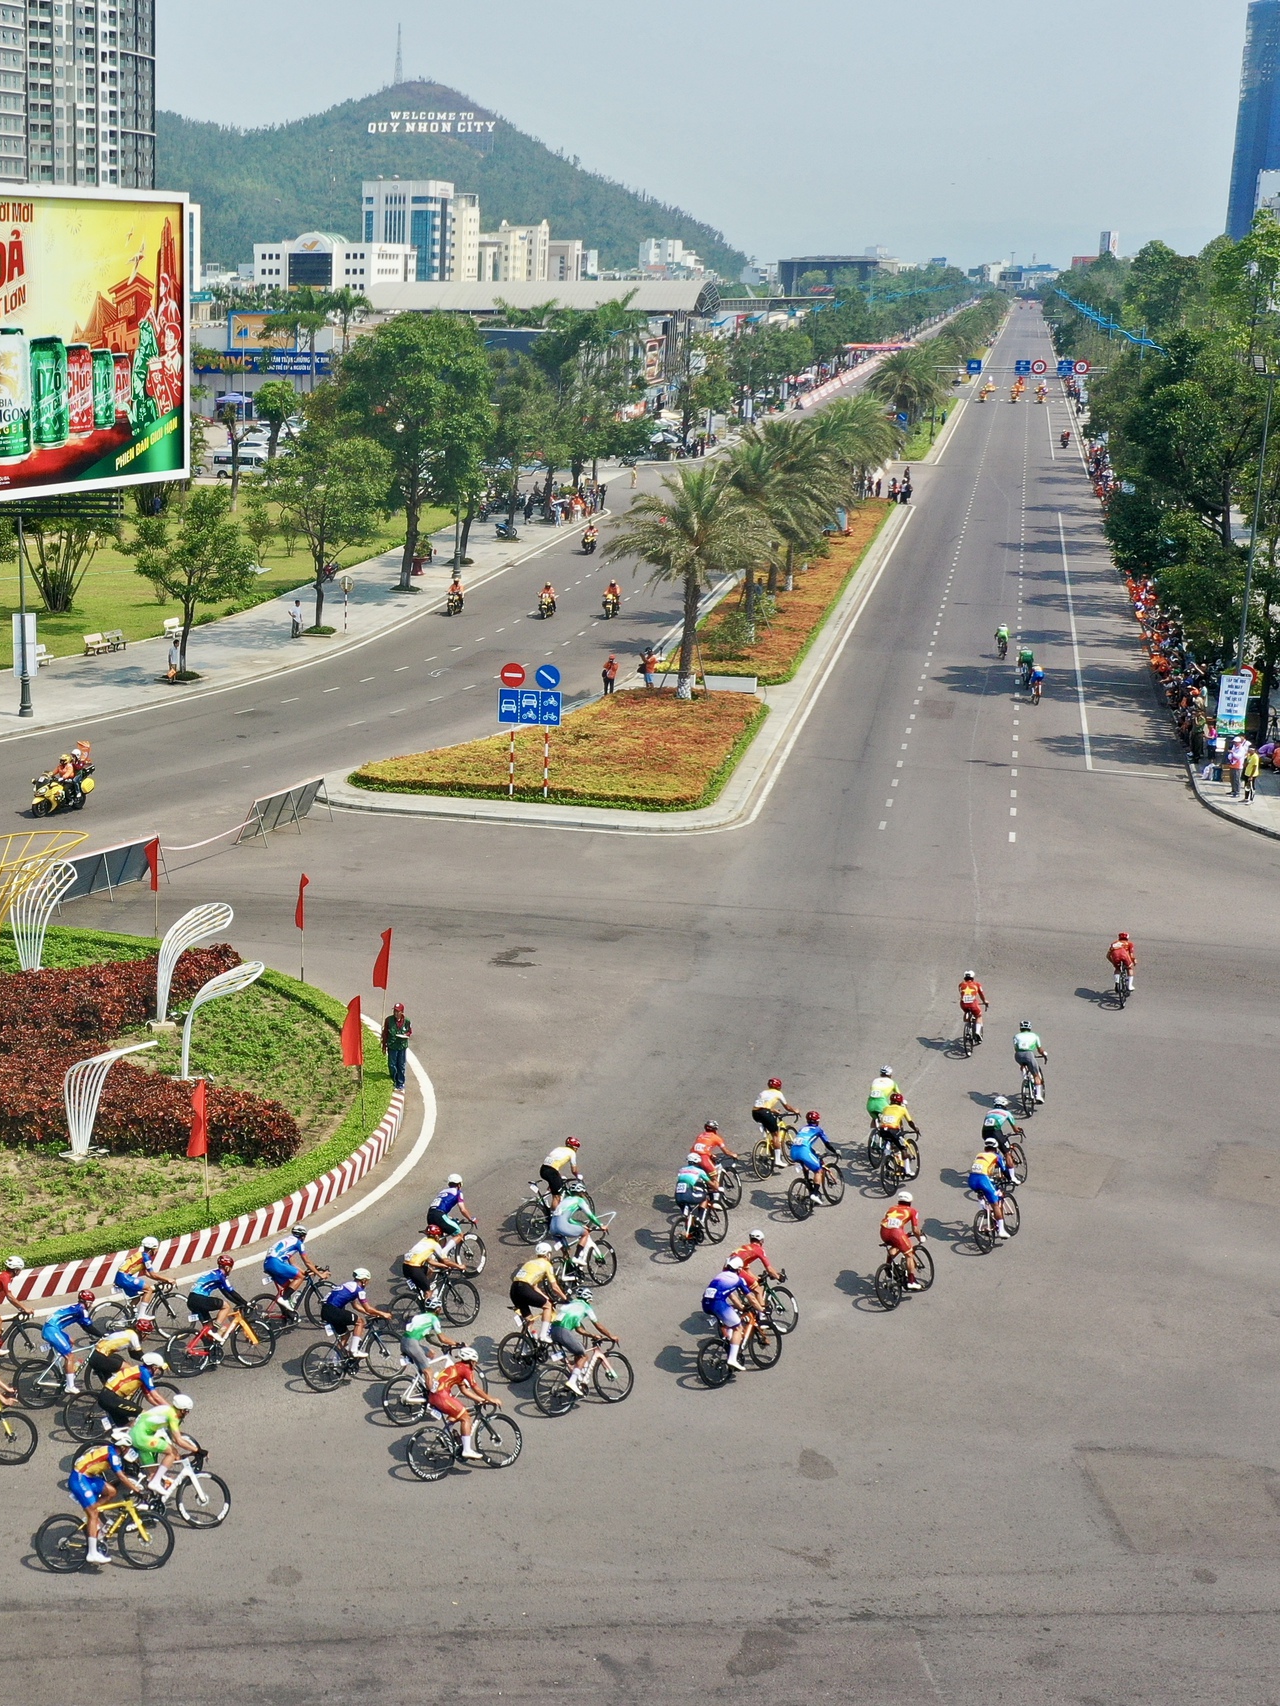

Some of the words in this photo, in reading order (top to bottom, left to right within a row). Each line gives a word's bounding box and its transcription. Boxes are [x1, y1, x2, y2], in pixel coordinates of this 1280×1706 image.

[367, 122, 400, 134] QUY
[405, 122, 452, 133] NHON
[457, 121, 496, 133] CITY
[390, 111, 456, 121] WELCOME
[459, 112, 474, 120] TO
[11, 202, 33, 223] MỜI
[3, 284, 26, 315] LỚN
[67, 369, 92, 397] CHÚC
[135, 436, 149, 457] BẢN
[164, 416, 178, 435] HẠN
